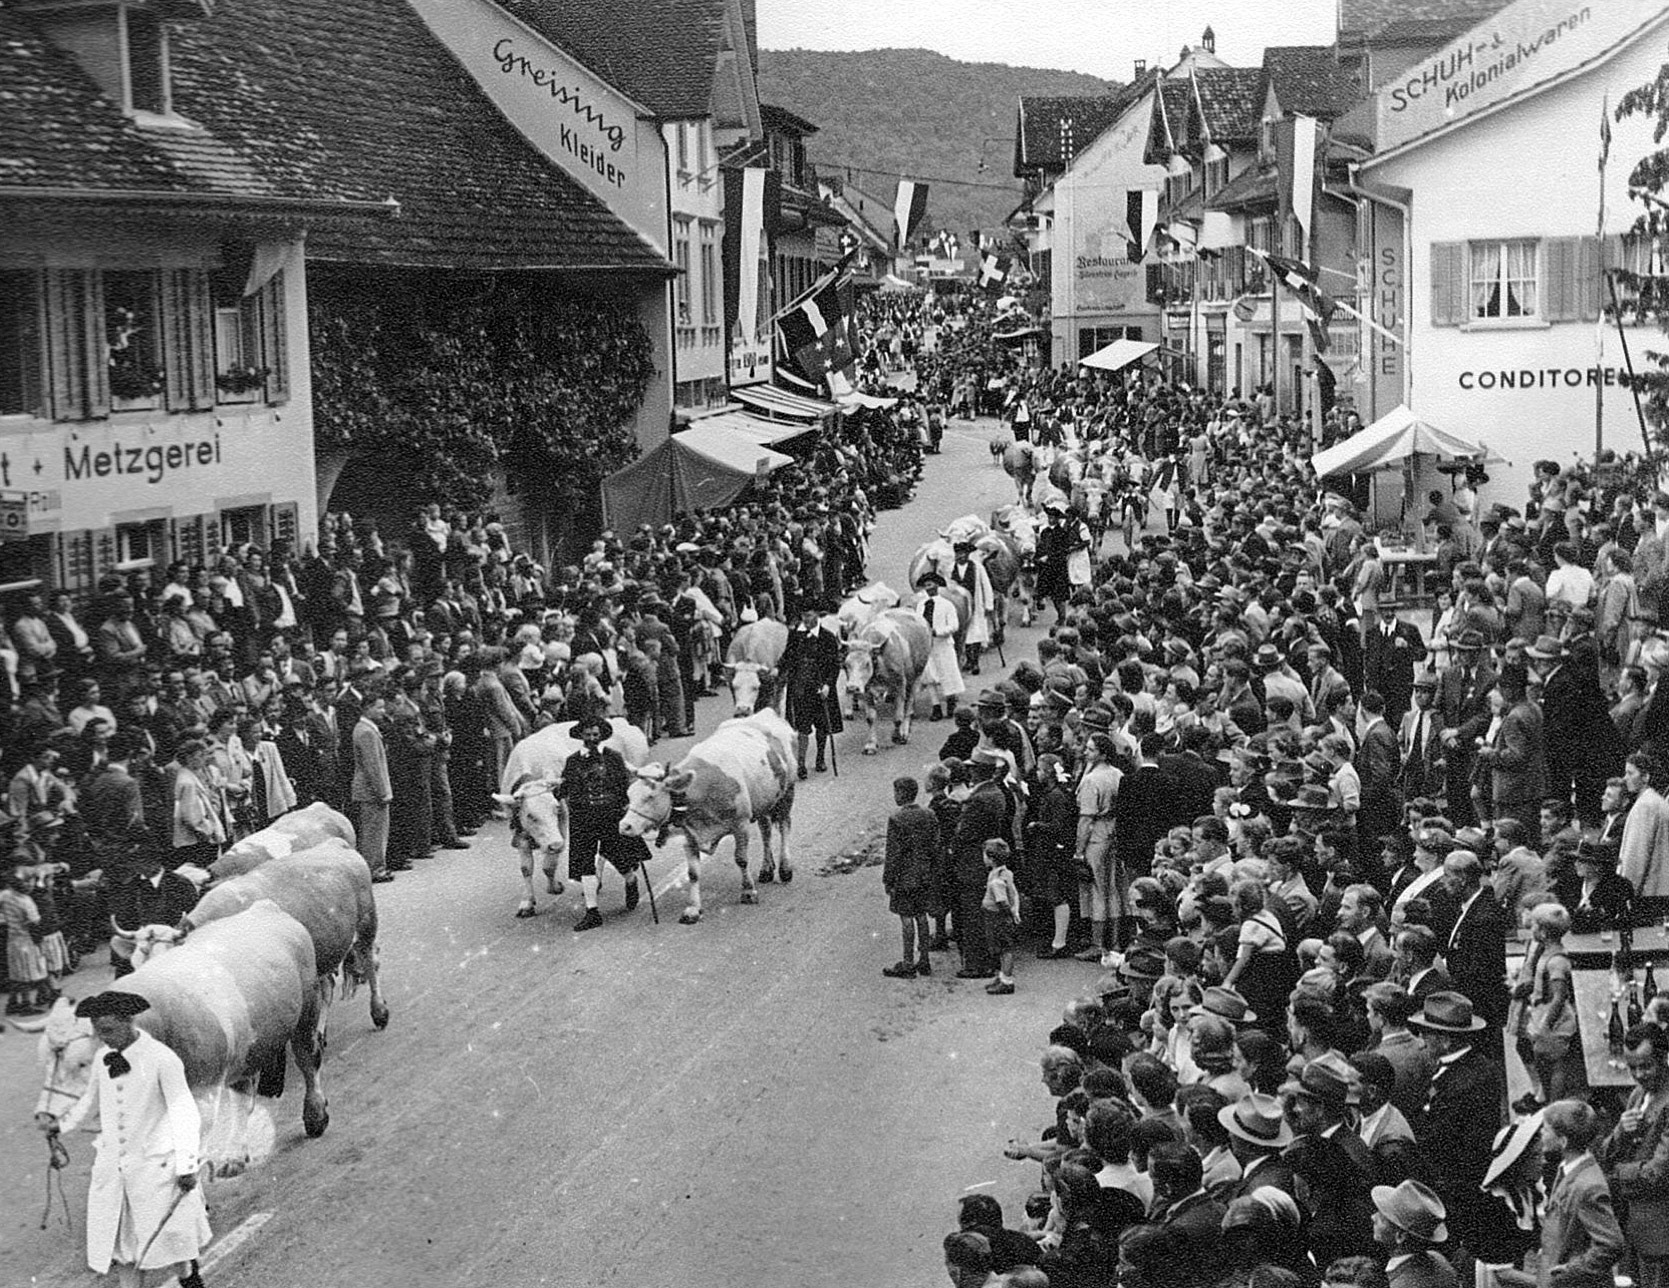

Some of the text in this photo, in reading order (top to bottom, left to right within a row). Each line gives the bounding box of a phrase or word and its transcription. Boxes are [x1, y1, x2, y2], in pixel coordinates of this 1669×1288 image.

[493, 38, 626, 152] Greising
[1446, 7, 1591, 108] Kolonialwaren
[560, 123, 625, 189] Kleider
[1077, 254, 1136, 268] Restauran
[1382, 248, 1396, 375] SCHUHE
[64, 432, 221, 484] Metzgerei
